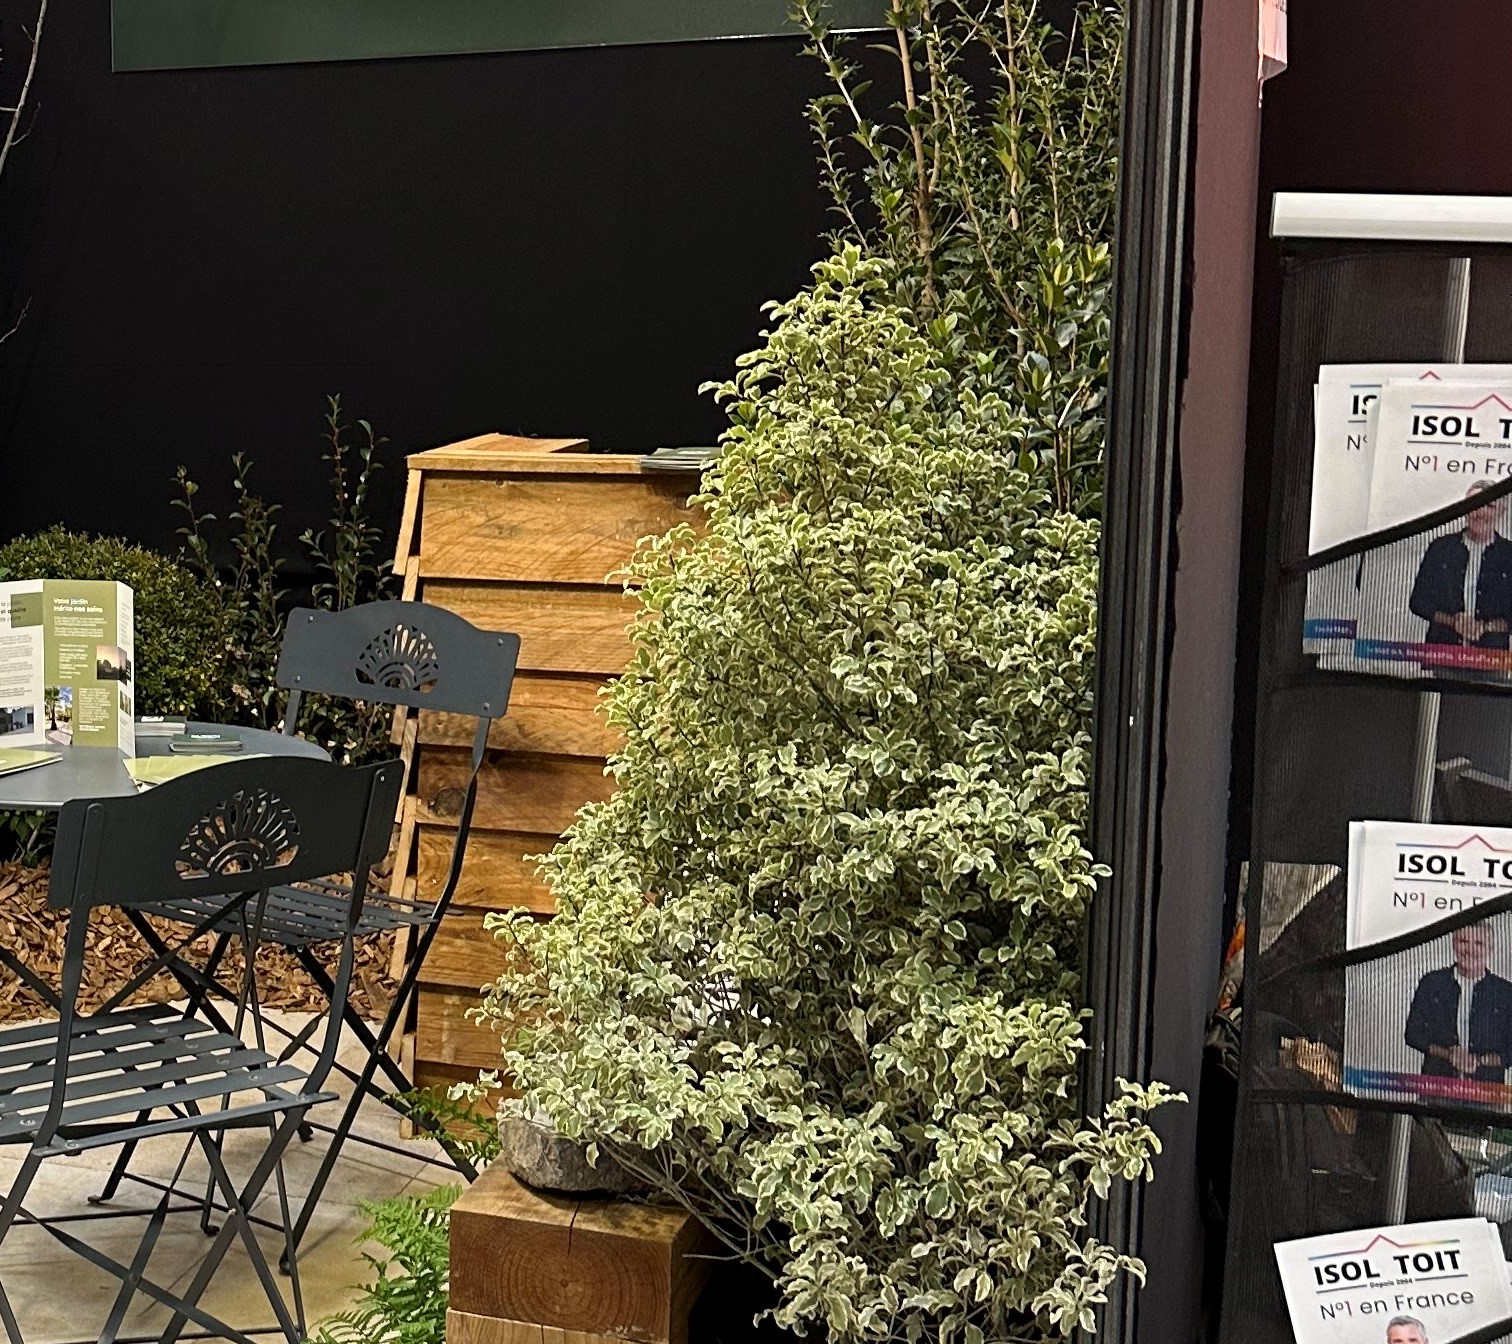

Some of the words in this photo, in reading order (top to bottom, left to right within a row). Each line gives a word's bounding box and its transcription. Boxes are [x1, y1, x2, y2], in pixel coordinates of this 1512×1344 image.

[1412, 415, 1480, 438] ISOL
[1447, 459, 1476, 474] en
[1399, 853, 1466, 877] ISOL
[1434, 897, 1463, 911] en
[1314, 1259, 1381, 1286] ISOL
[1393, 1249, 1461, 1275] TOIT
[1360, 1299, 1388, 1315] en
[1394, 1290, 1475, 1311] France
